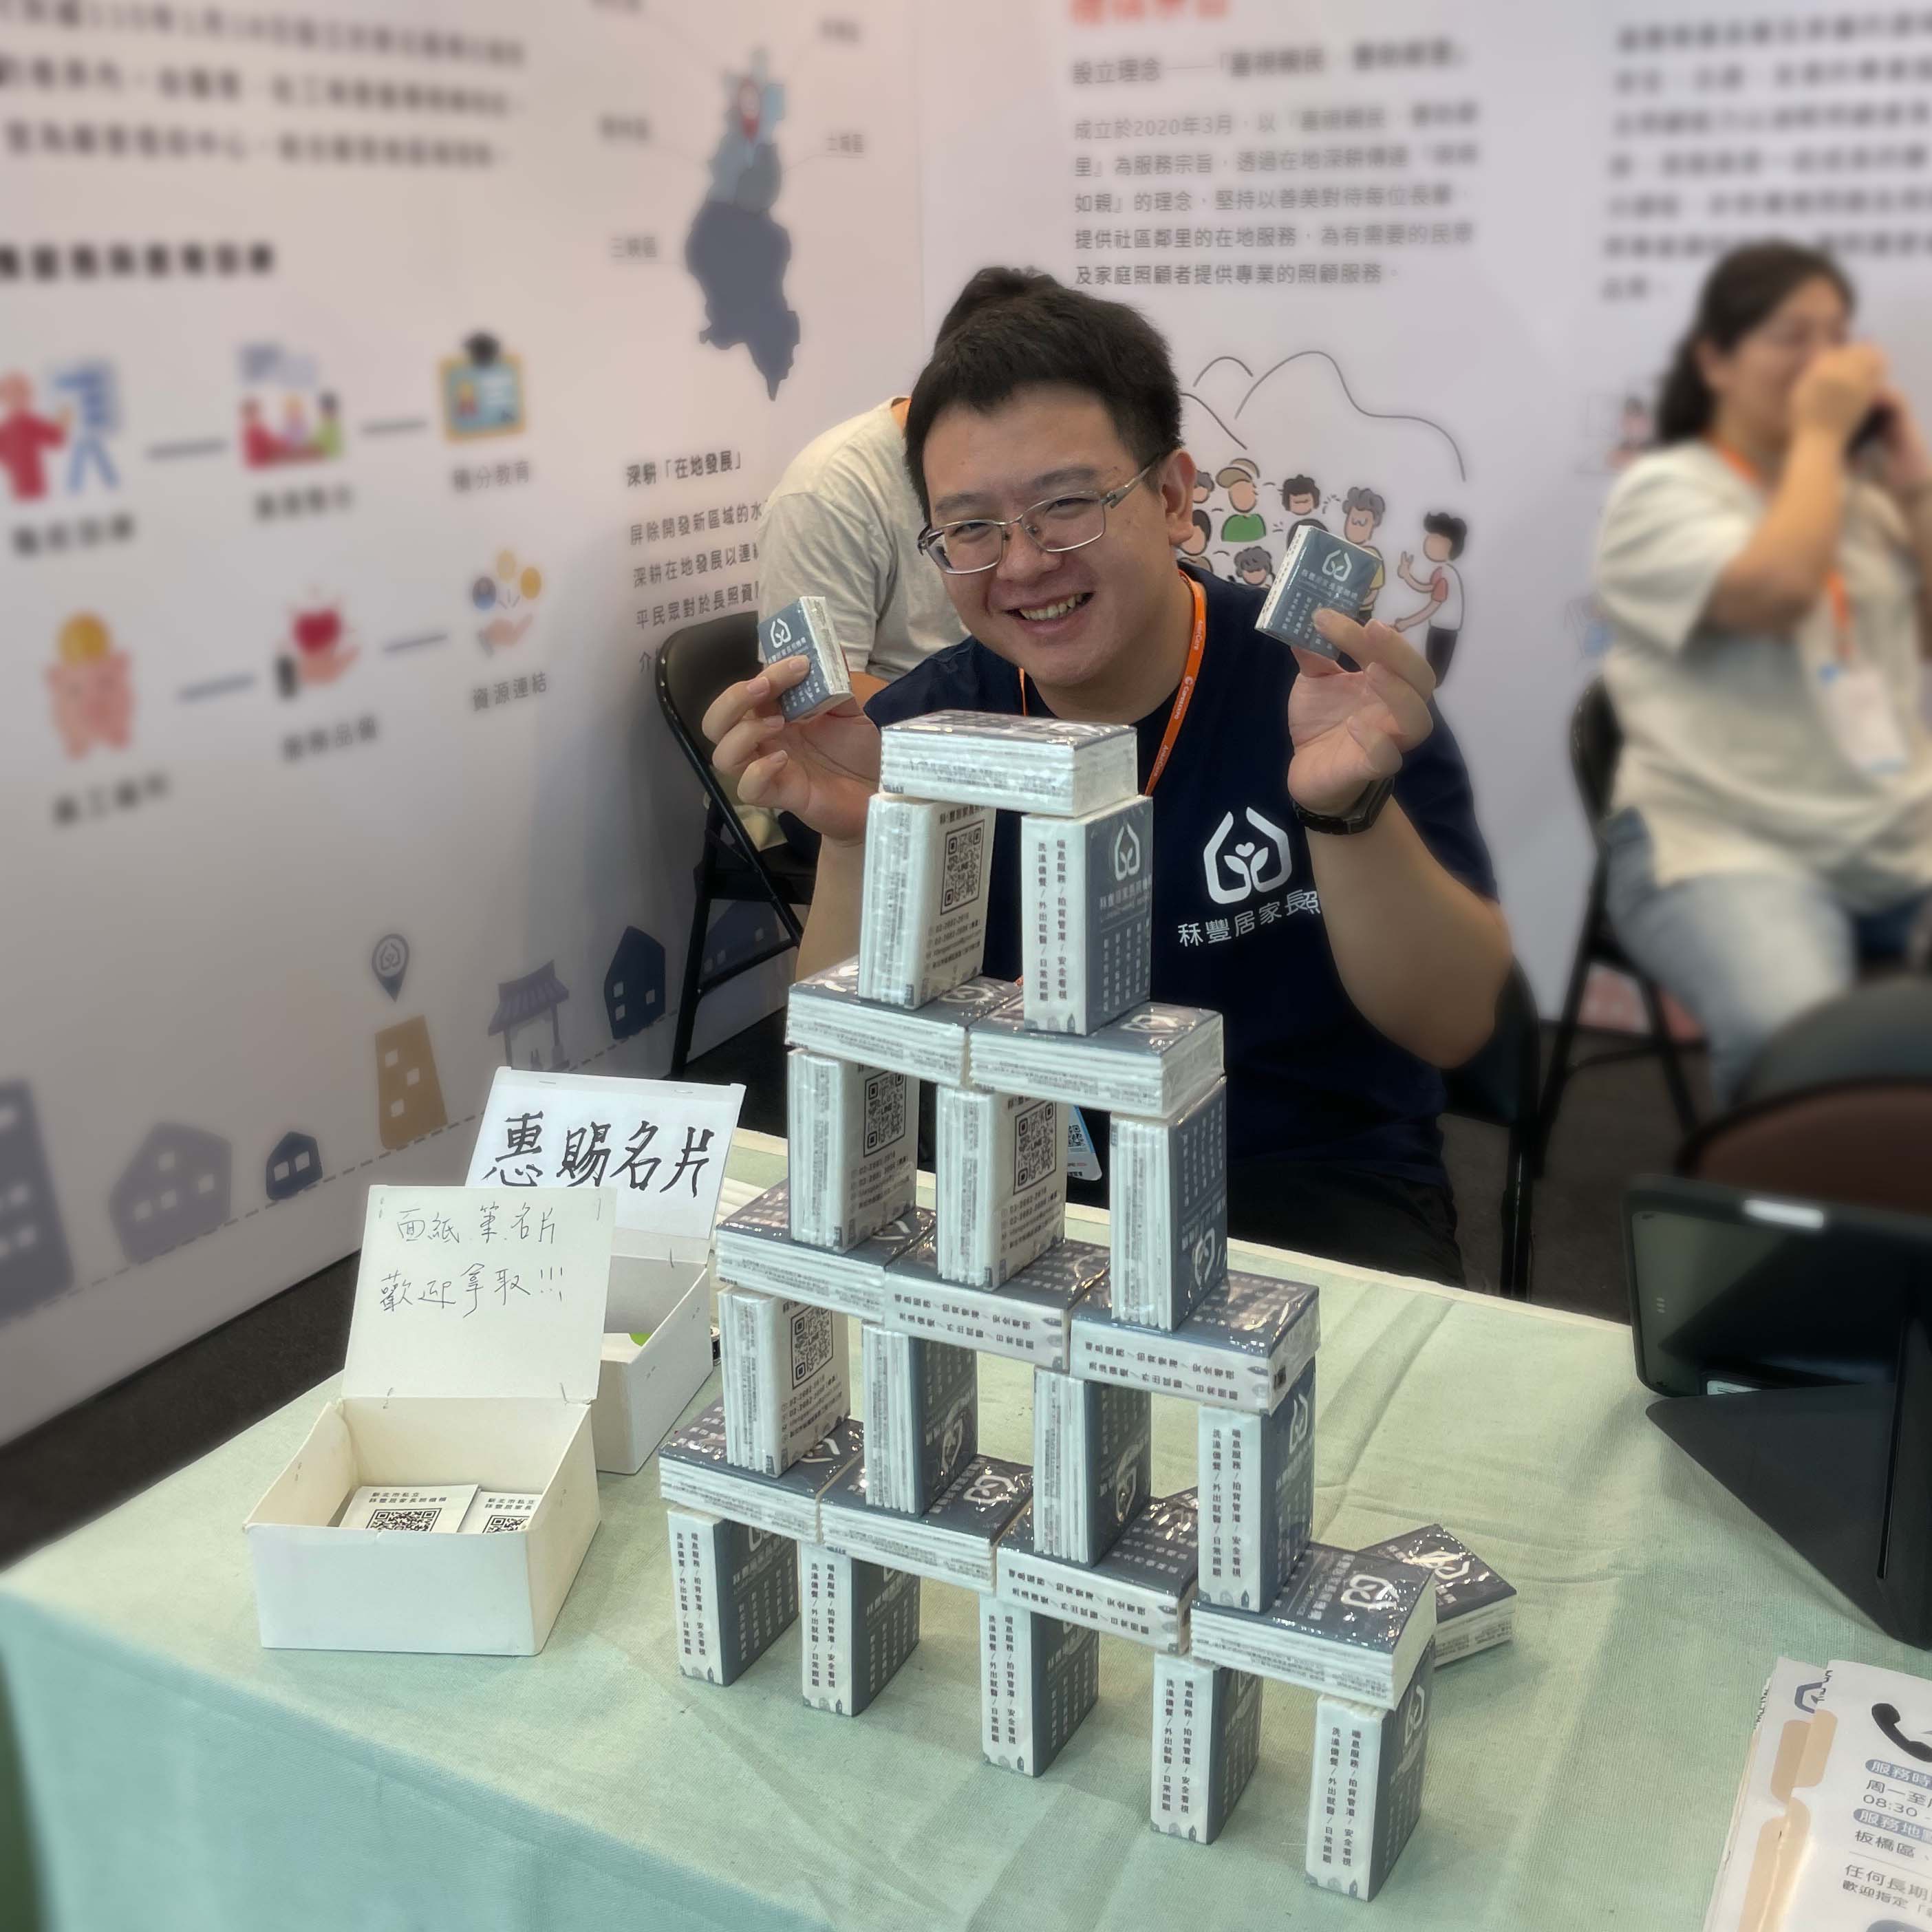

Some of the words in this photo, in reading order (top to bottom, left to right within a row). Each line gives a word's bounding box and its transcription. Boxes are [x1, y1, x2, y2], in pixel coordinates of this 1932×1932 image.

[482, 1110, 716, 1198] 惠賜名片
[1863, 1794, 1918, 1817] 08:30
[1866, 1779, 1932, 1809] 周一至
